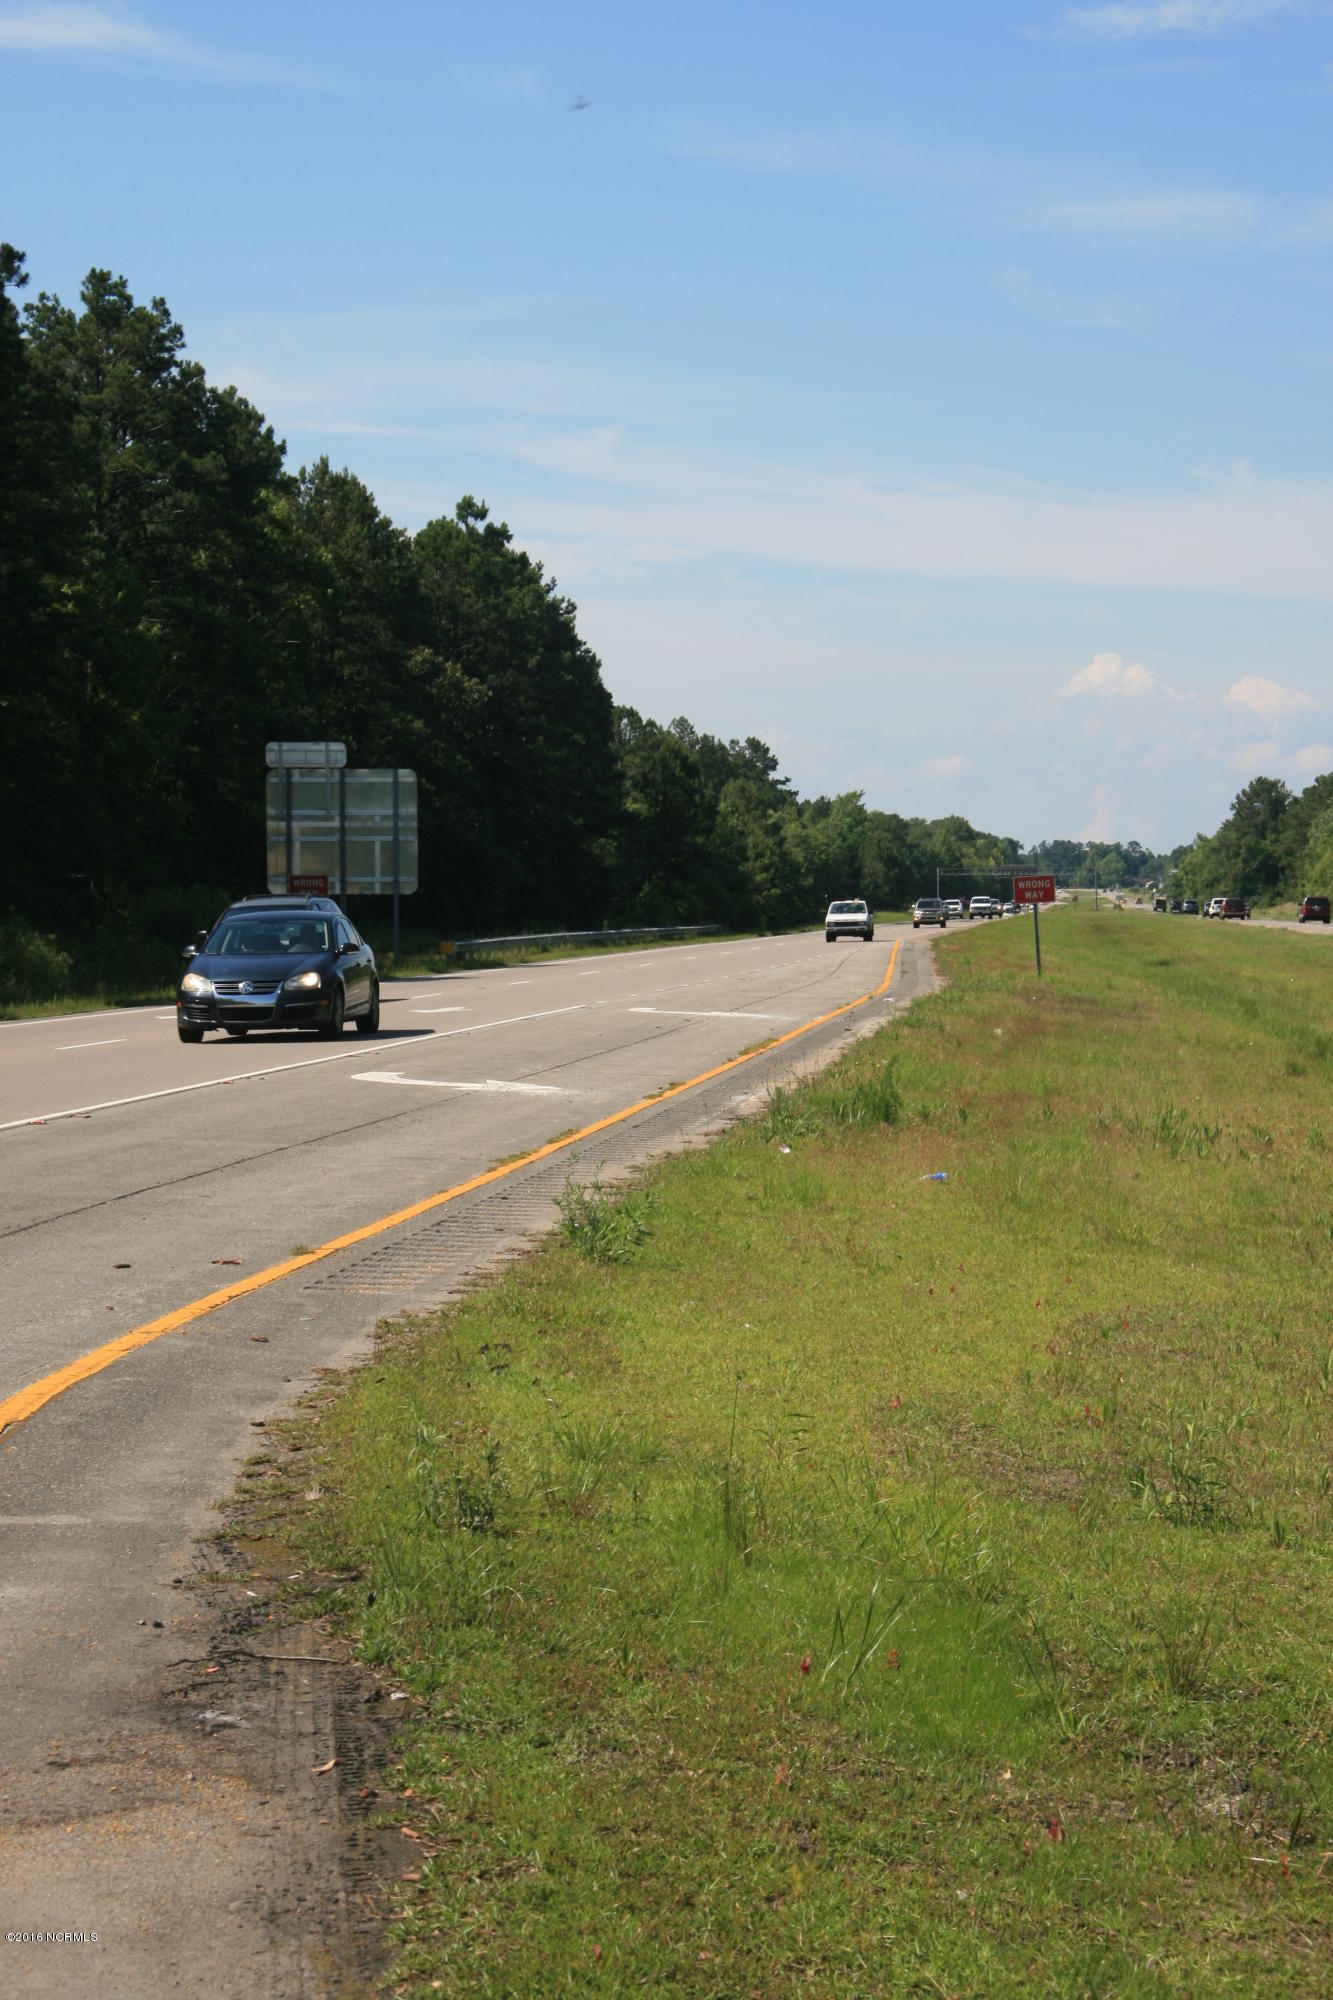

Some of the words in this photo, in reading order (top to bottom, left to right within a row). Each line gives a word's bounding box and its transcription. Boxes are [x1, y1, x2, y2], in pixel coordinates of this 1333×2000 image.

[293, 878, 324, 888] WRONG
[1018, 879, 1051, 889] WRONG
[1024, 890, 1044, 899] WAY
